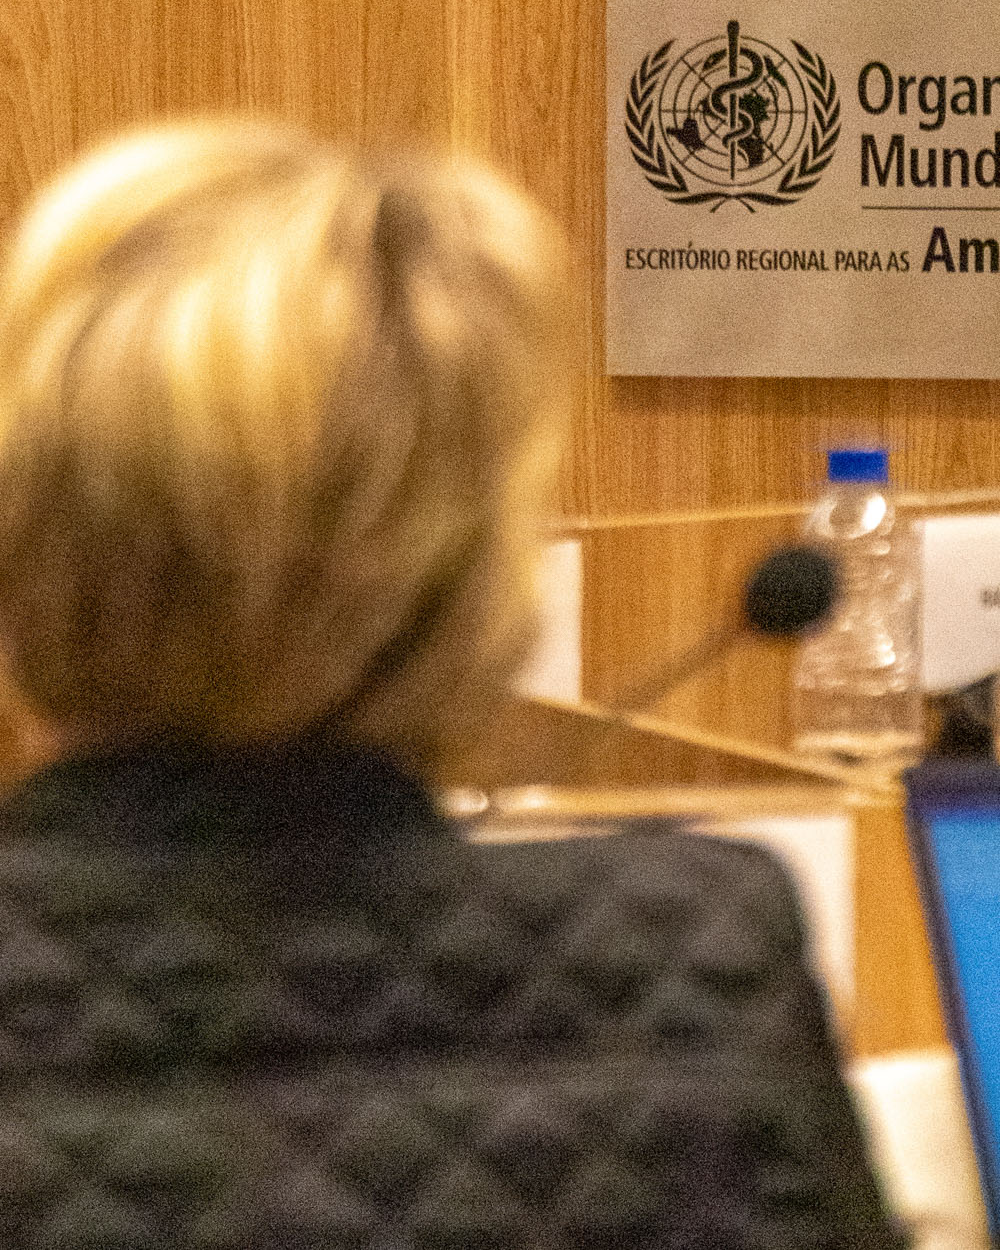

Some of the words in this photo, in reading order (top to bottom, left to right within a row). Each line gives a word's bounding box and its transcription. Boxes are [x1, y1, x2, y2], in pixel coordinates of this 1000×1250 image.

[625, 241, 731, 271] ESCRITÓRIO
[736, 250, 830, 272] REGIONAL
[834, 250, 883, 272] PARA
[886, 250, 910, 272] AS
